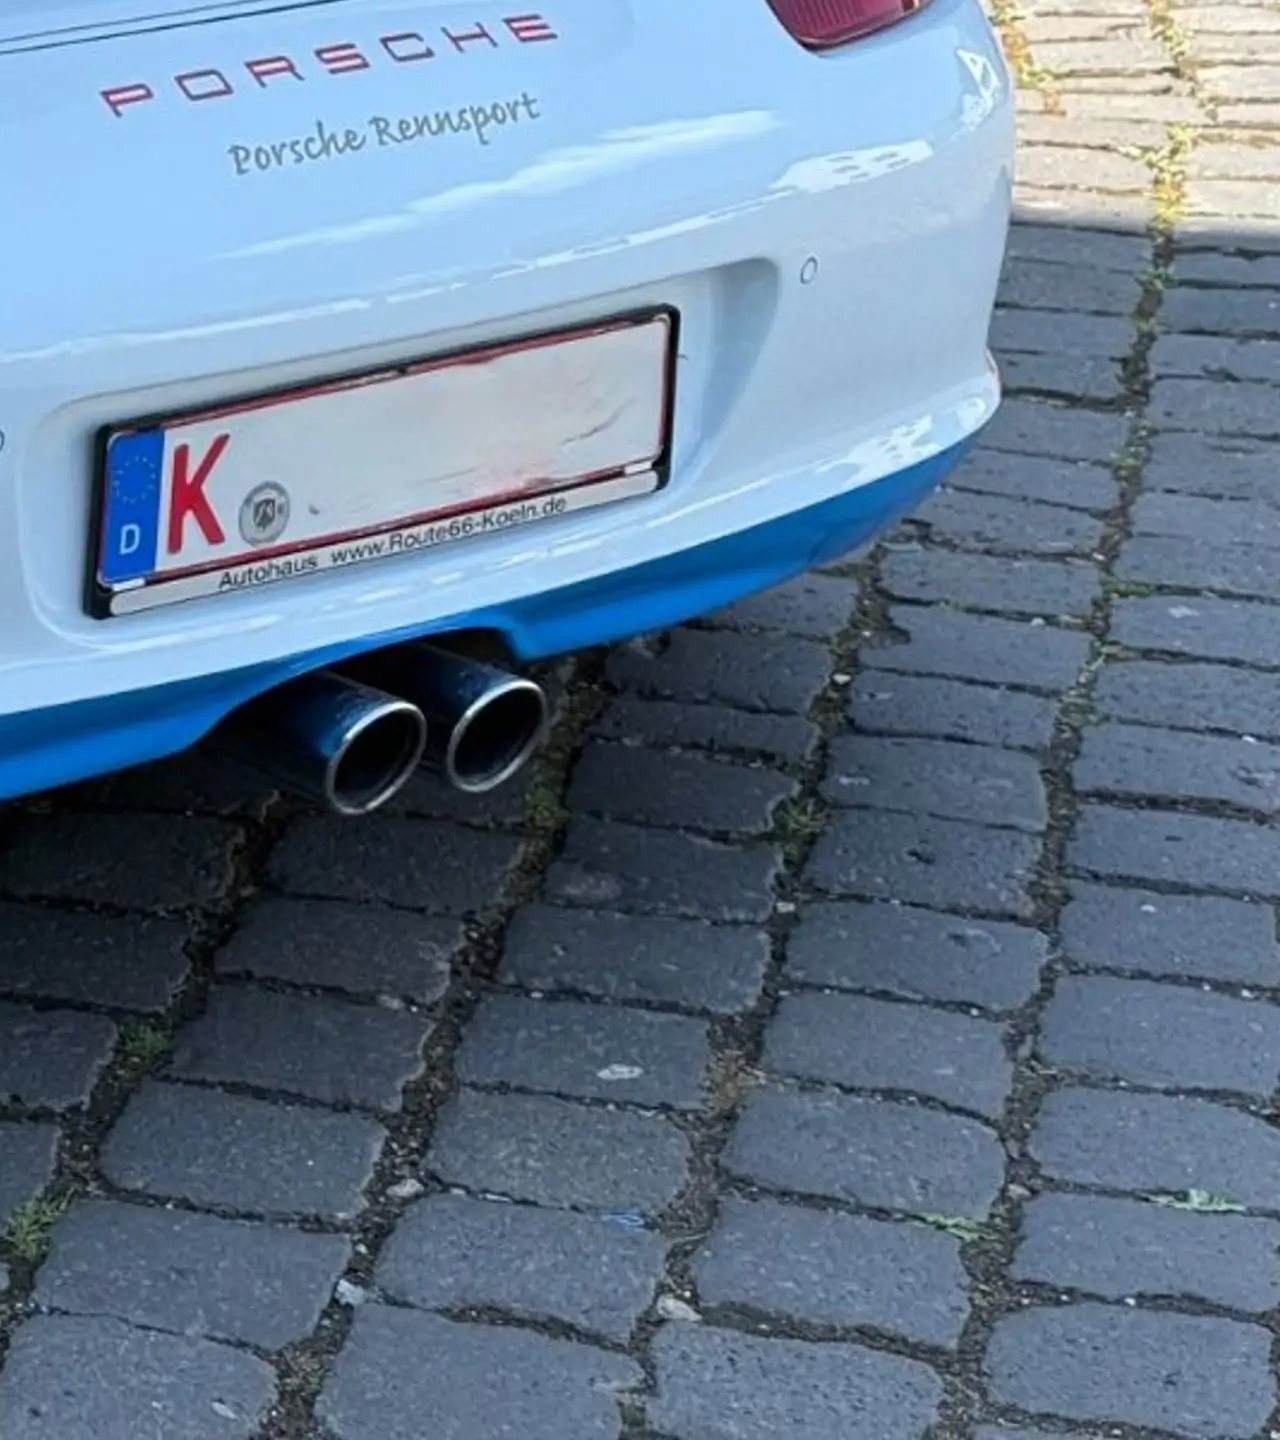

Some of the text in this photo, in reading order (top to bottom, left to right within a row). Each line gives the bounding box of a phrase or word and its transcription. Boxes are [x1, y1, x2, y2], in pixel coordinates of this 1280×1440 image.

[99, 13, 559, 118] PORSCHE
[226, 90, 542, 176] Porsche Rennsport
[119, 522, 141, 556] D
[167, 433, 231, 556] K
[218, 494, 568, 591] Autohaus www.Route66-Koeln.de
